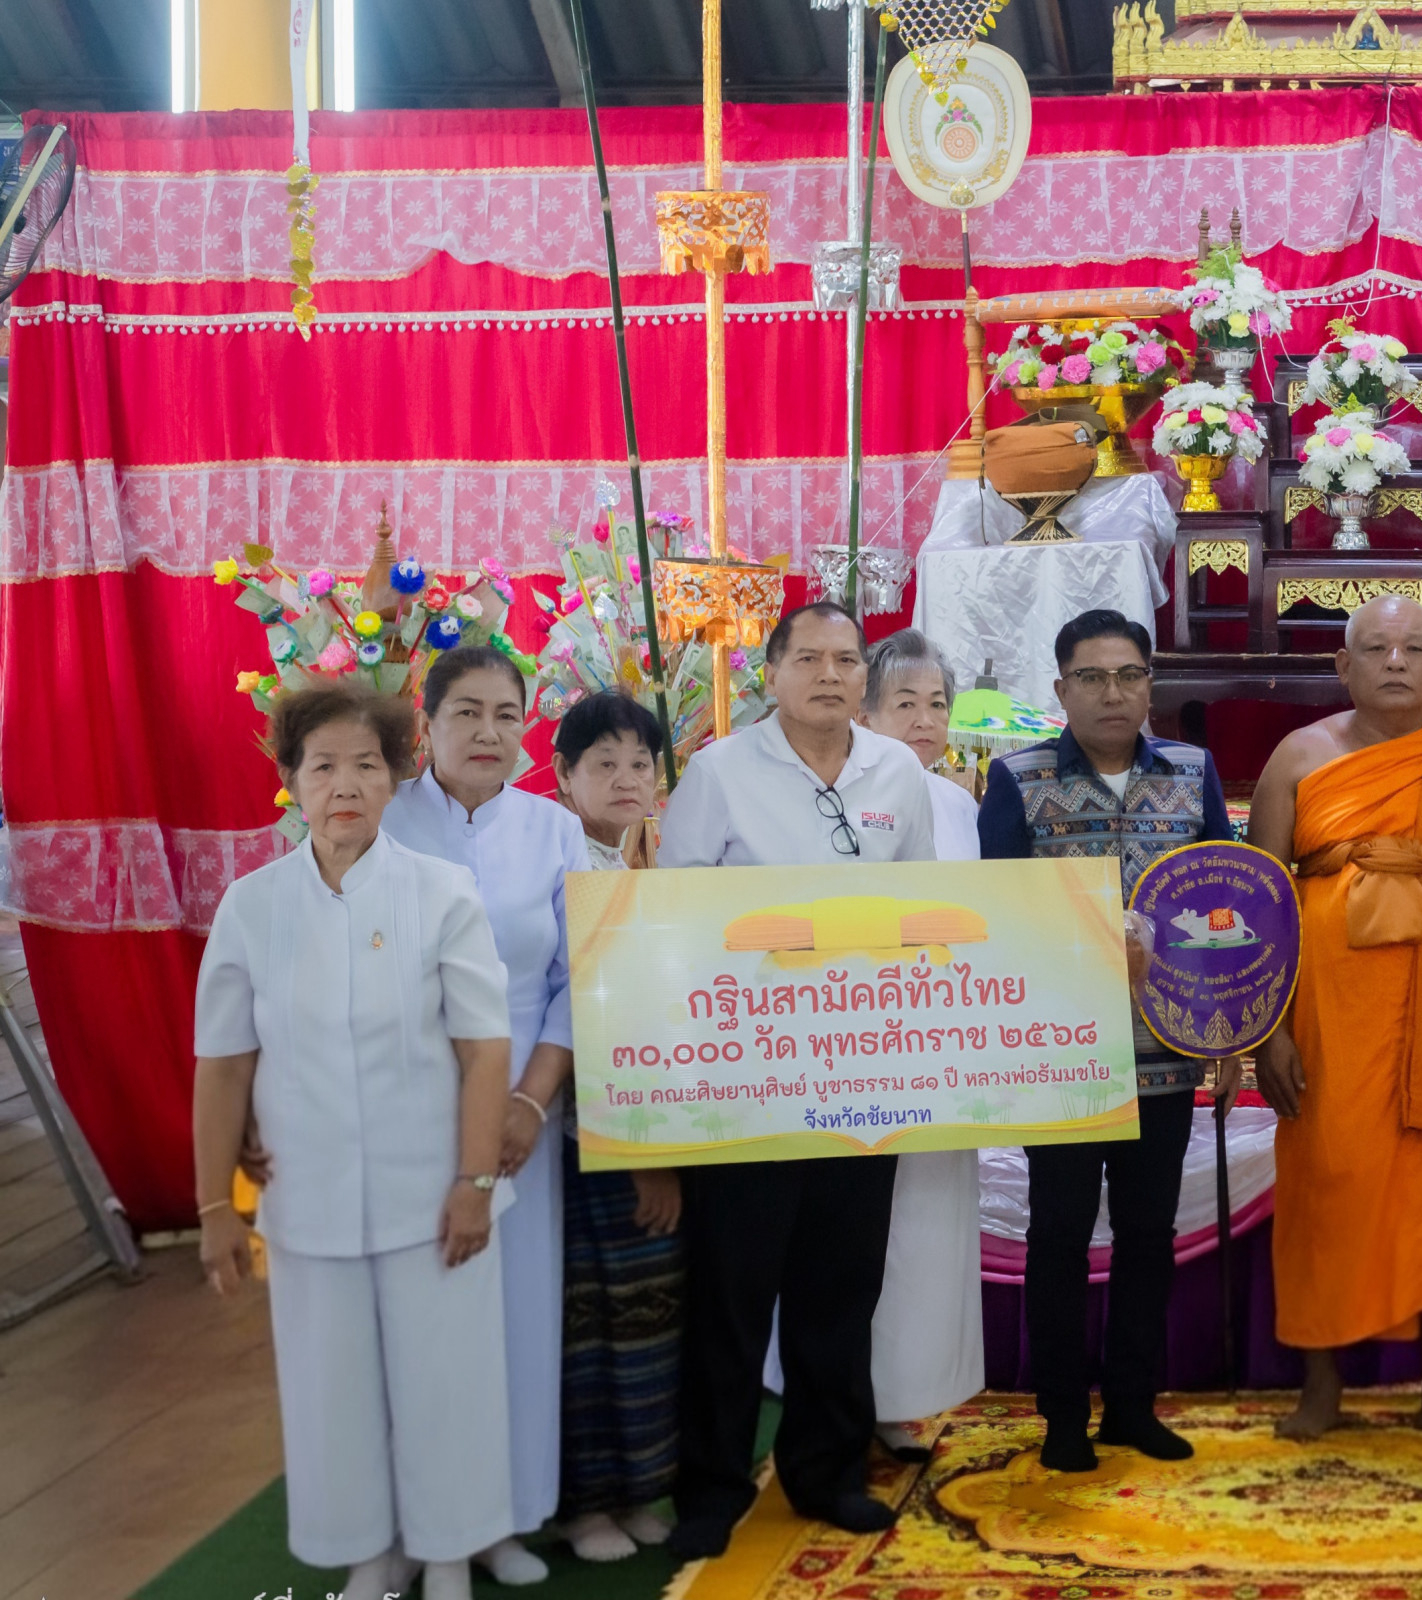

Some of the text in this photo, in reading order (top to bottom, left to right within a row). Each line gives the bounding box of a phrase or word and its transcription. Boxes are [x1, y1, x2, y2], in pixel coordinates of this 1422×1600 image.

[861, 811, 894, 823] ISUZU
[688, 953, 1026, 1031] กฐินสามัคคีทั่วไทย
[612, 1018, 1098, 1071] ๓๐,๐๐๐ วัด พุทธศักราช ๒๕๖๘
[605, 1059, 1110, 1107] โดย คณะศิษยานุศิษย์ บูชาธรรม ๘๑ ปี หลวงพ่อธัมมชโย
[803, 1104, 932, 1130] จังหวัดชัยนาท
